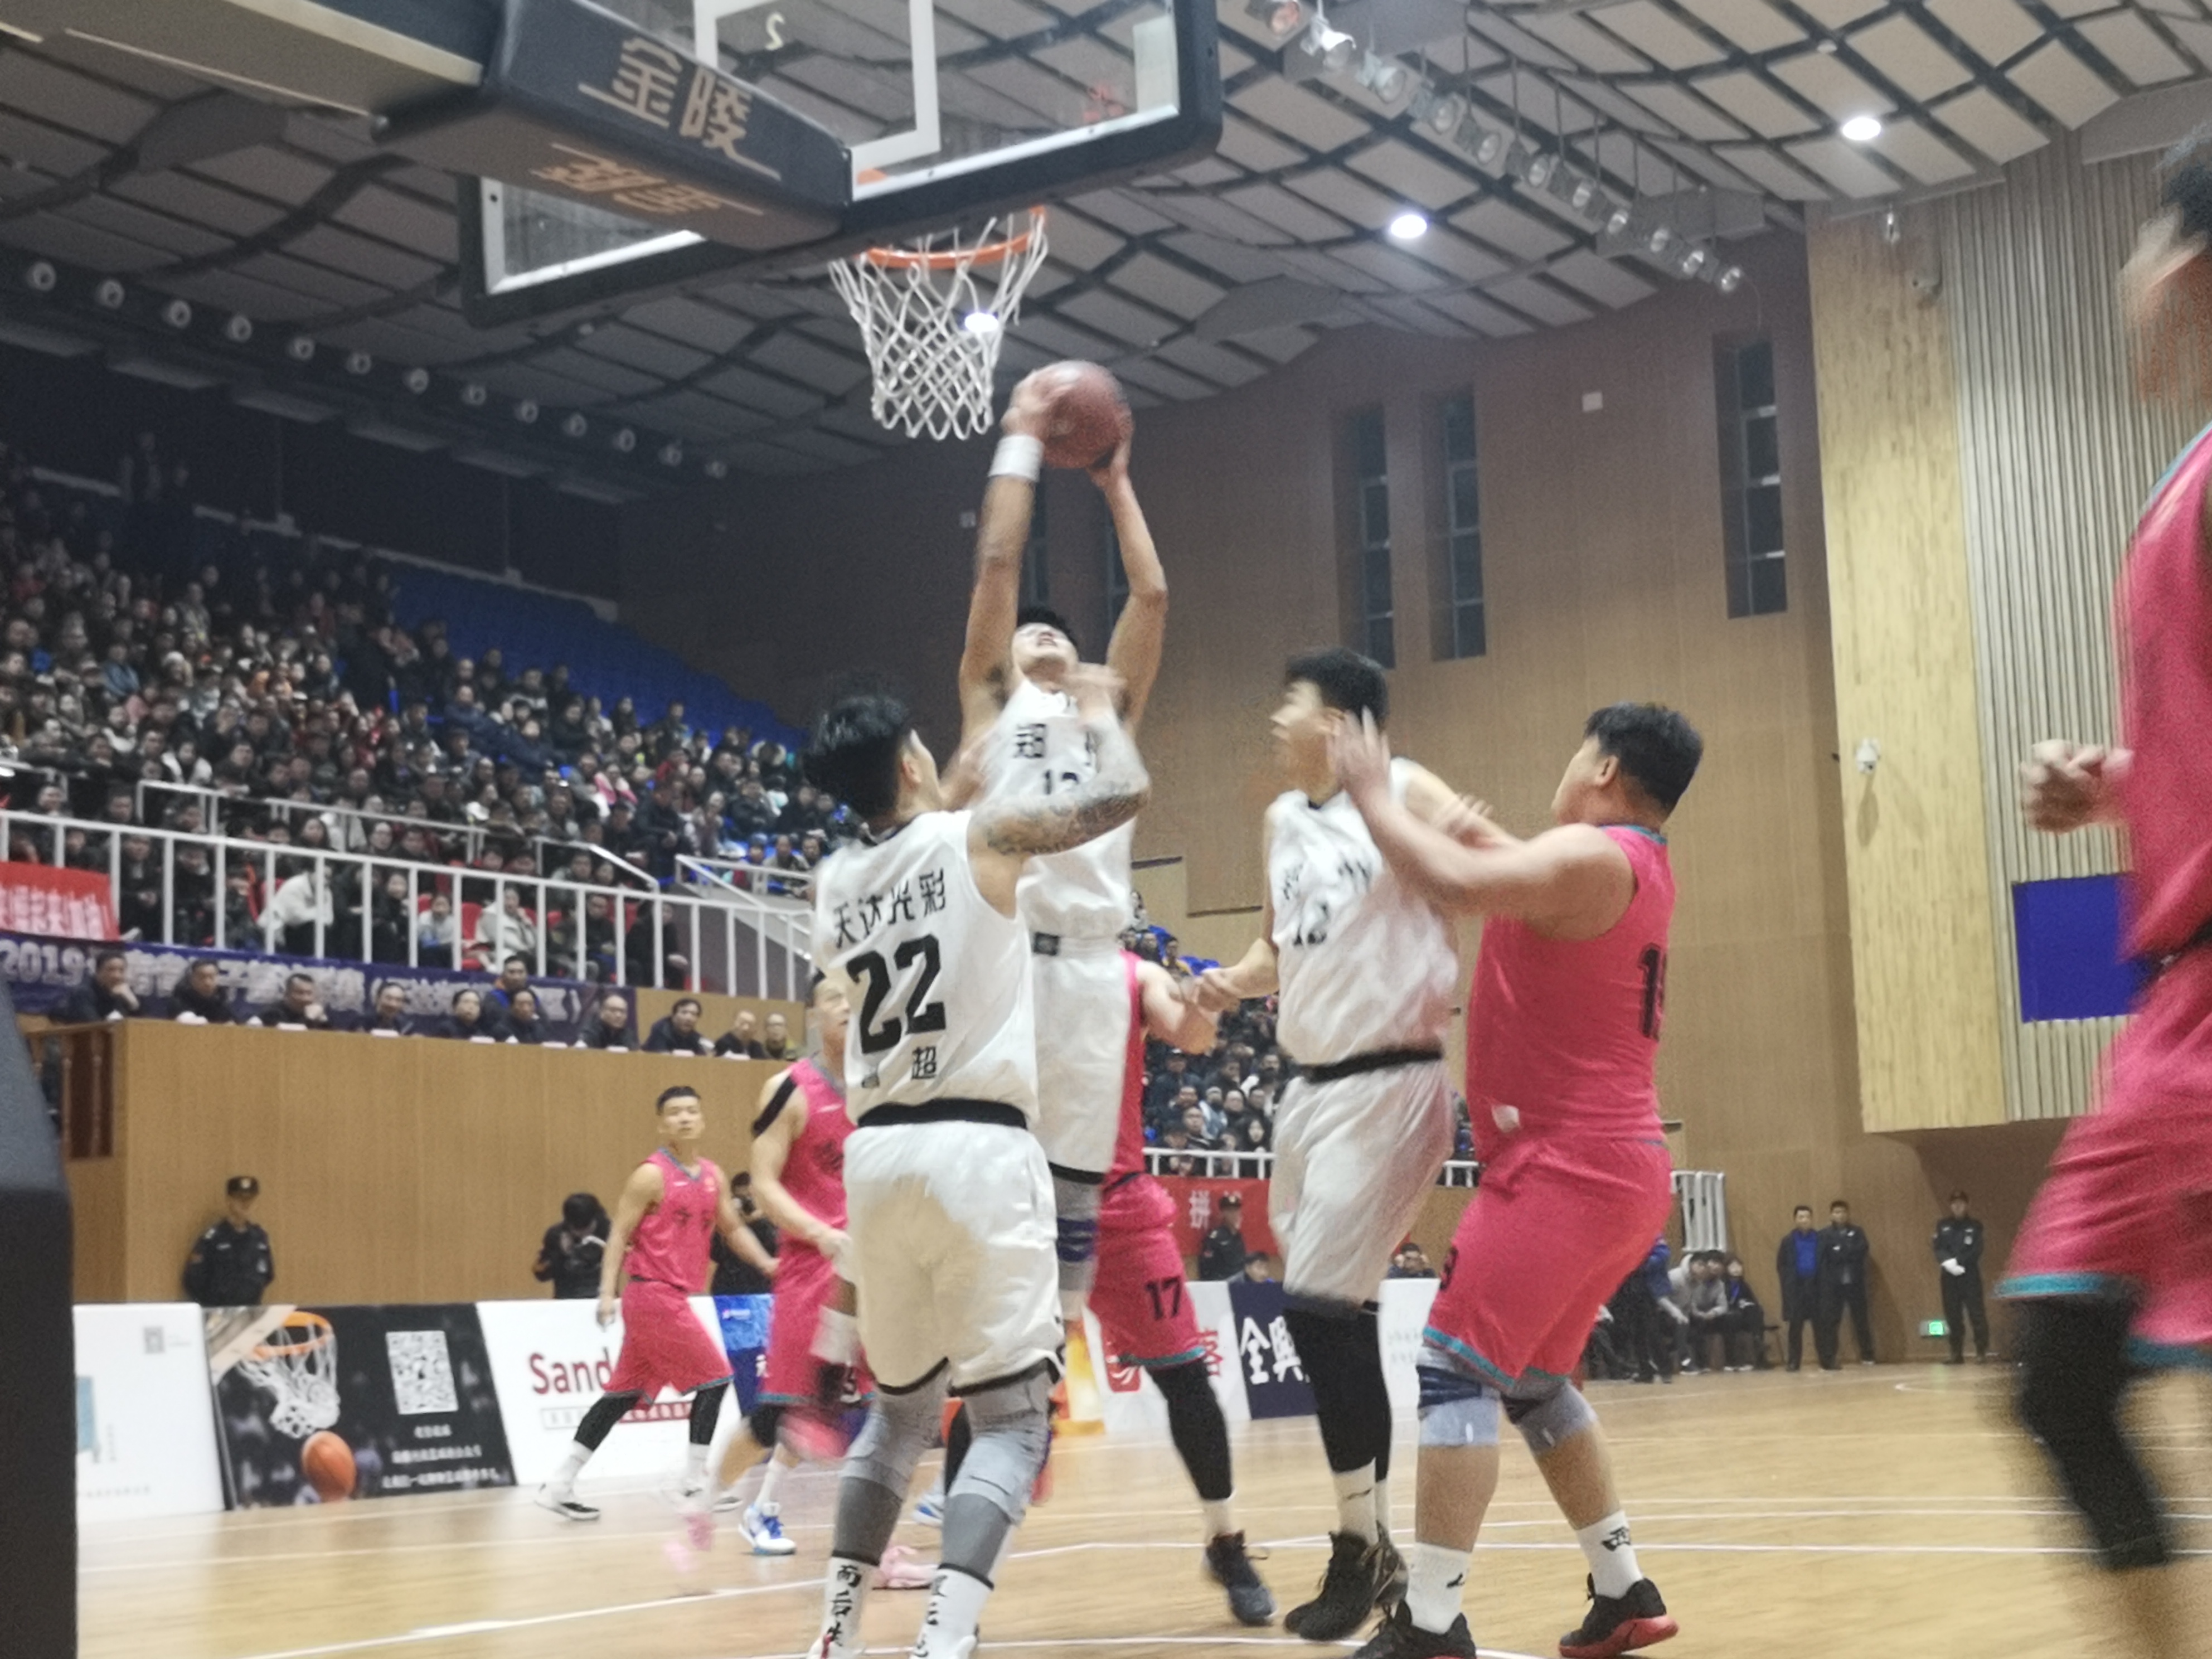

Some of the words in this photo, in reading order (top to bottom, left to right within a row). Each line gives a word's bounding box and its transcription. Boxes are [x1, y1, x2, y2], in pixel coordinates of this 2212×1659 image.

[578, 38, 780, 182] 金陵
[846, 934, 946, 1054] 22
[1145, 1275, 1182, 1320] 17
[529, 1346, 613, 1394] Sand
